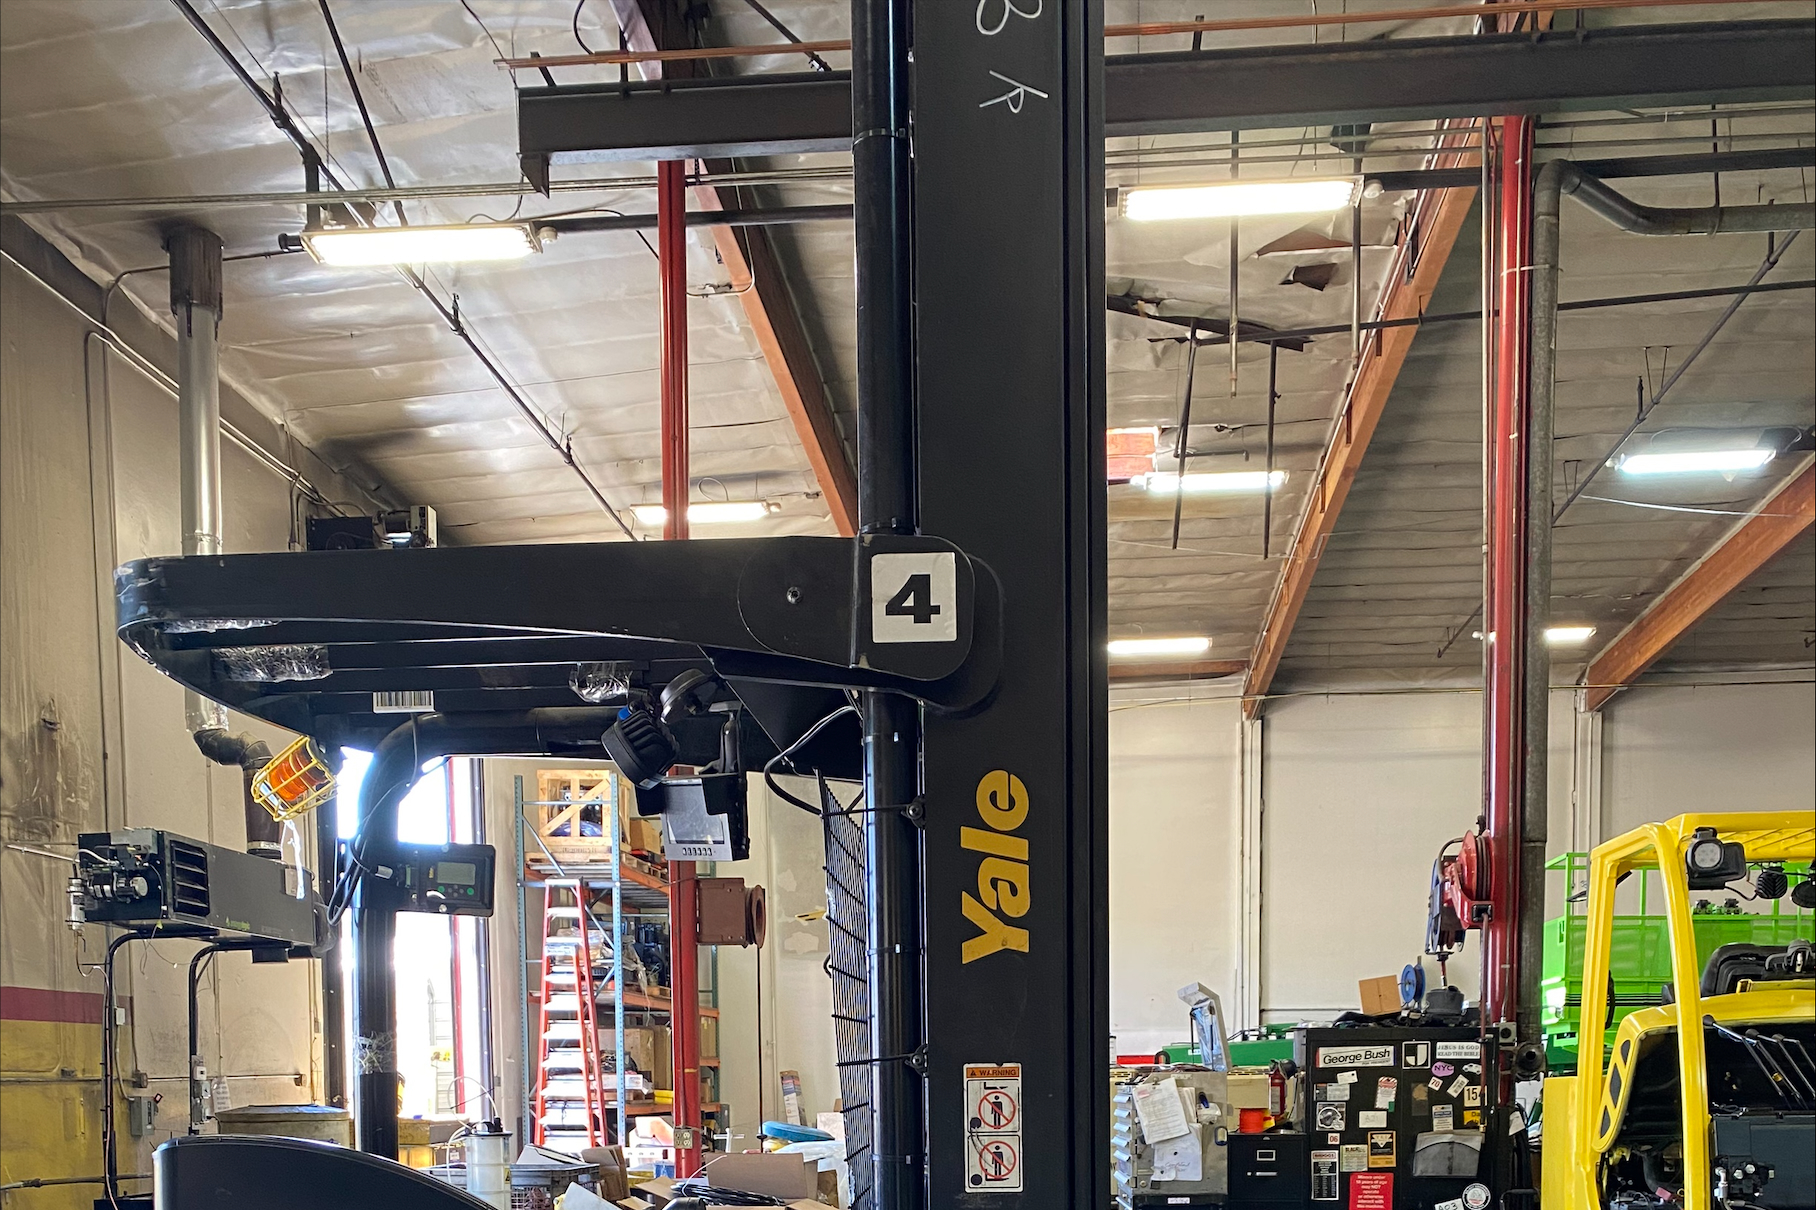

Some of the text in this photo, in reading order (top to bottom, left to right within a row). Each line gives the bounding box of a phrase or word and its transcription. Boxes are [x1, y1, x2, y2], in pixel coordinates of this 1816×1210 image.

[885, 573, 941, 624] 4
[960, 769, 1031, 965] Yale
[1323, 1048, 1390, 1064] George Bush
[979, 1069, 1017, 1077] WARNING
[1431, 1078, 1441, 1087] 70
[1465, 1087, 1481, 1101] 15
